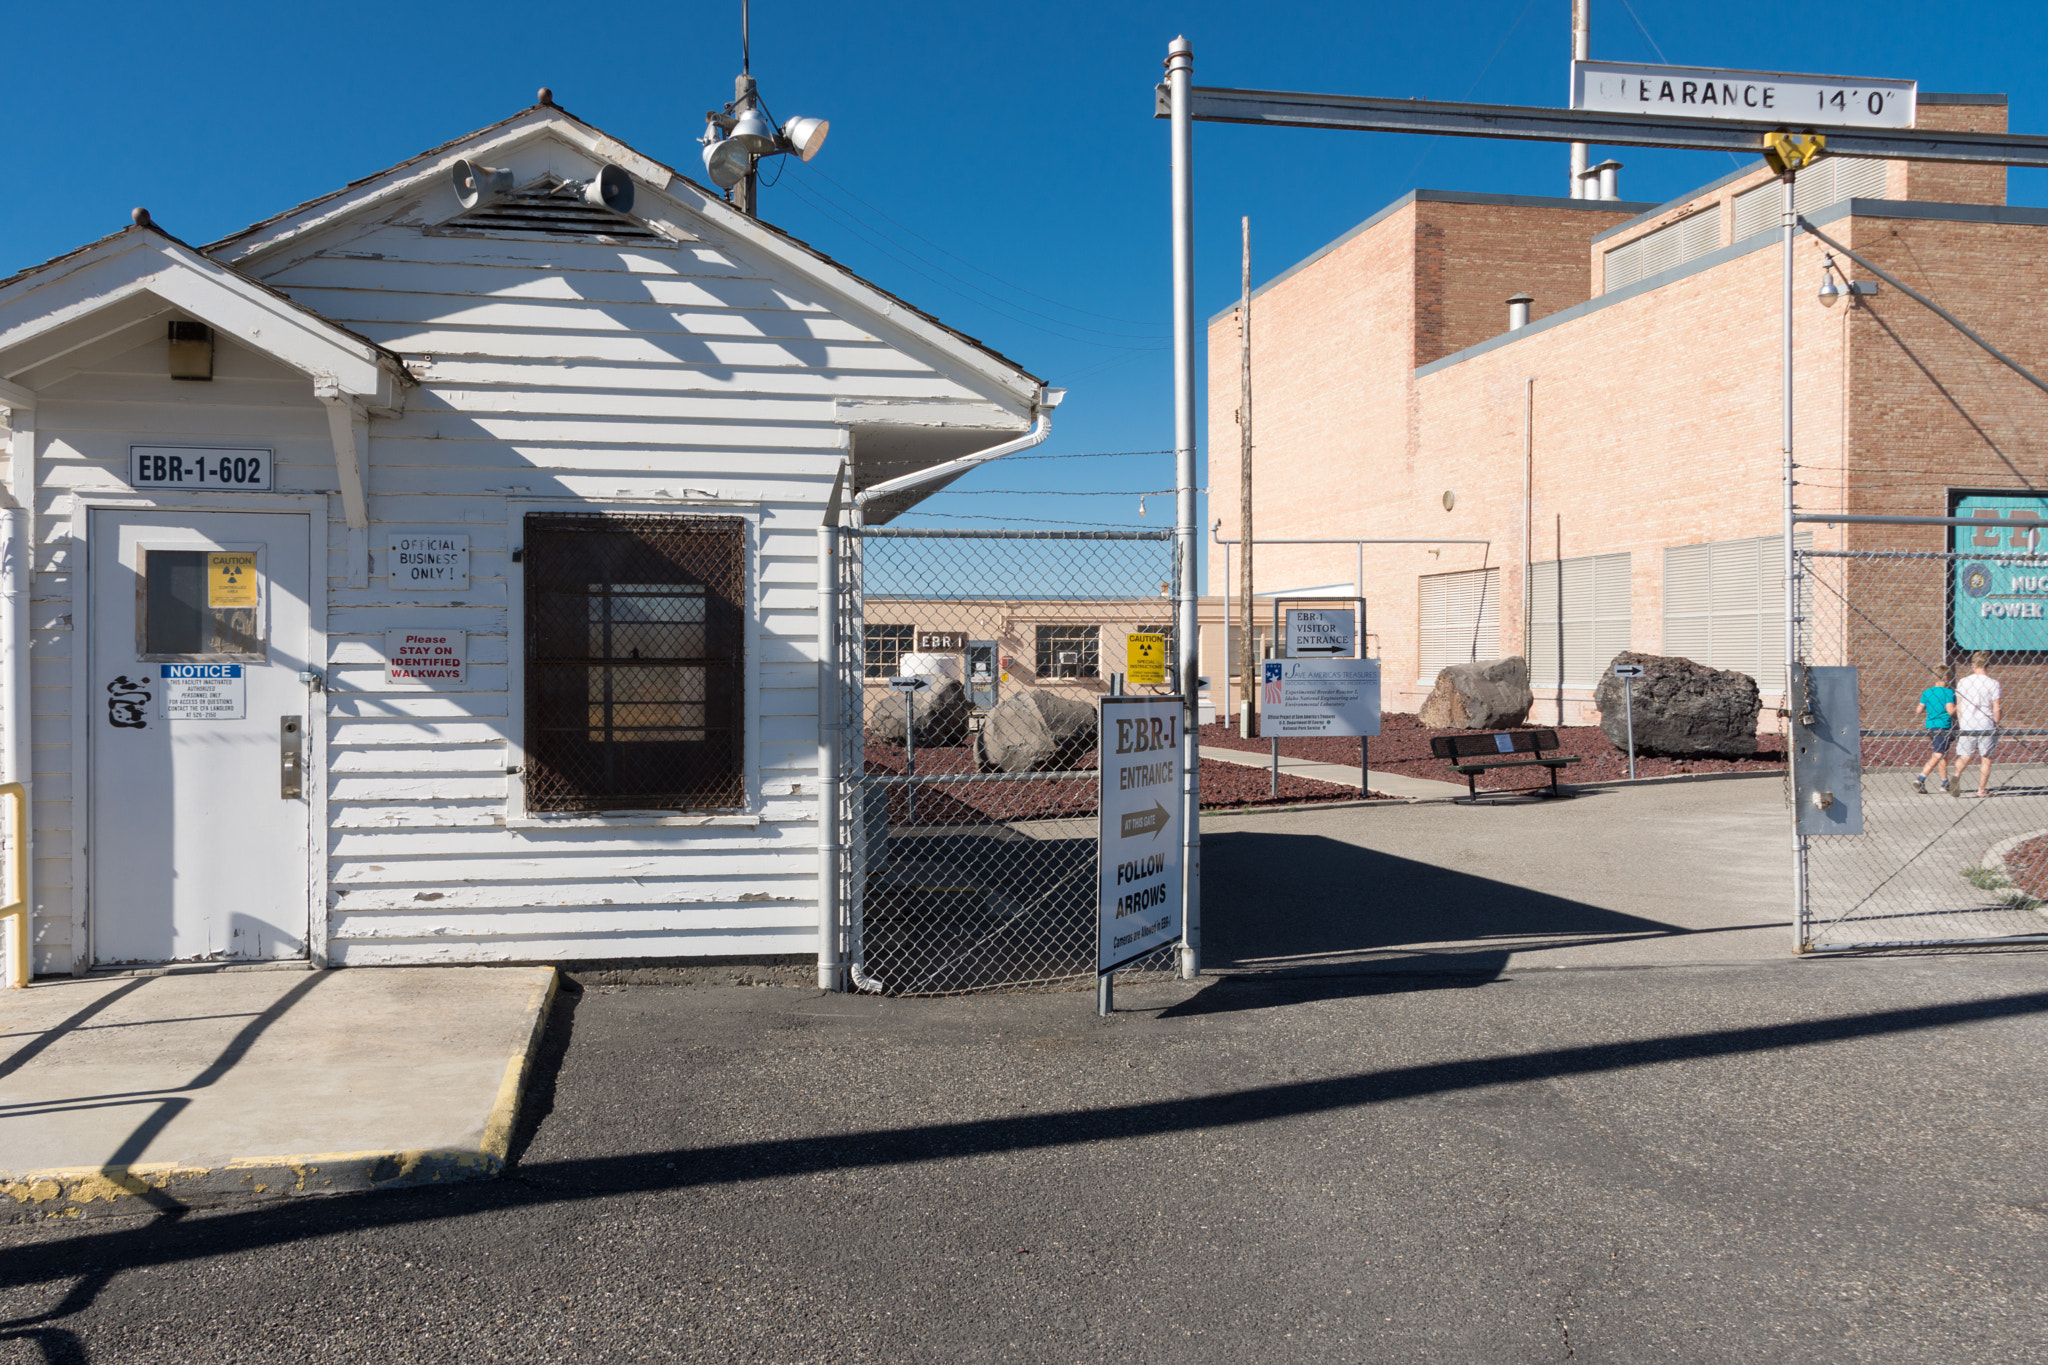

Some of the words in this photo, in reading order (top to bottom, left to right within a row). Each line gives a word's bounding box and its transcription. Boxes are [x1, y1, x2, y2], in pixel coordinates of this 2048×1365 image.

[139, 455, 260, 483] EBR-1-602
[401, 539, 456, 550] OFFICIAL
[400, 553, 458, 564] BUSINESS
[1981, 602, 2043, 619] POWER
[1297, 624, 1336, 632] VISITOR
[406, 635, 447, 643] Please
[922, 636, 951, 647] EBR
[1296, 635, 1348, 644] ENTRANCE
[400, 646, 430, 654] STAY
[391, 658, 460, 667] IDENTIFIED
[170, 665, 232, 677] NOTICE
[391, 669, 460, 678] WALKWAYS
[1285, 663, 1306, 679] SAVE
[1116, 716, 1176, 754] EBR-I
[1120, 761, 1173, 790] ENTRANCE
[1125, 819, 1132, 831] AT
[1132, 817, 1143, 829] THIS
[1144, 815, 1156, 827] GATE
[1117, 852, 1165, 886] FOLLOW
[1116, 883, 1166, 920] ARROWS
[1114, 933, 1132, 949] Cameras
